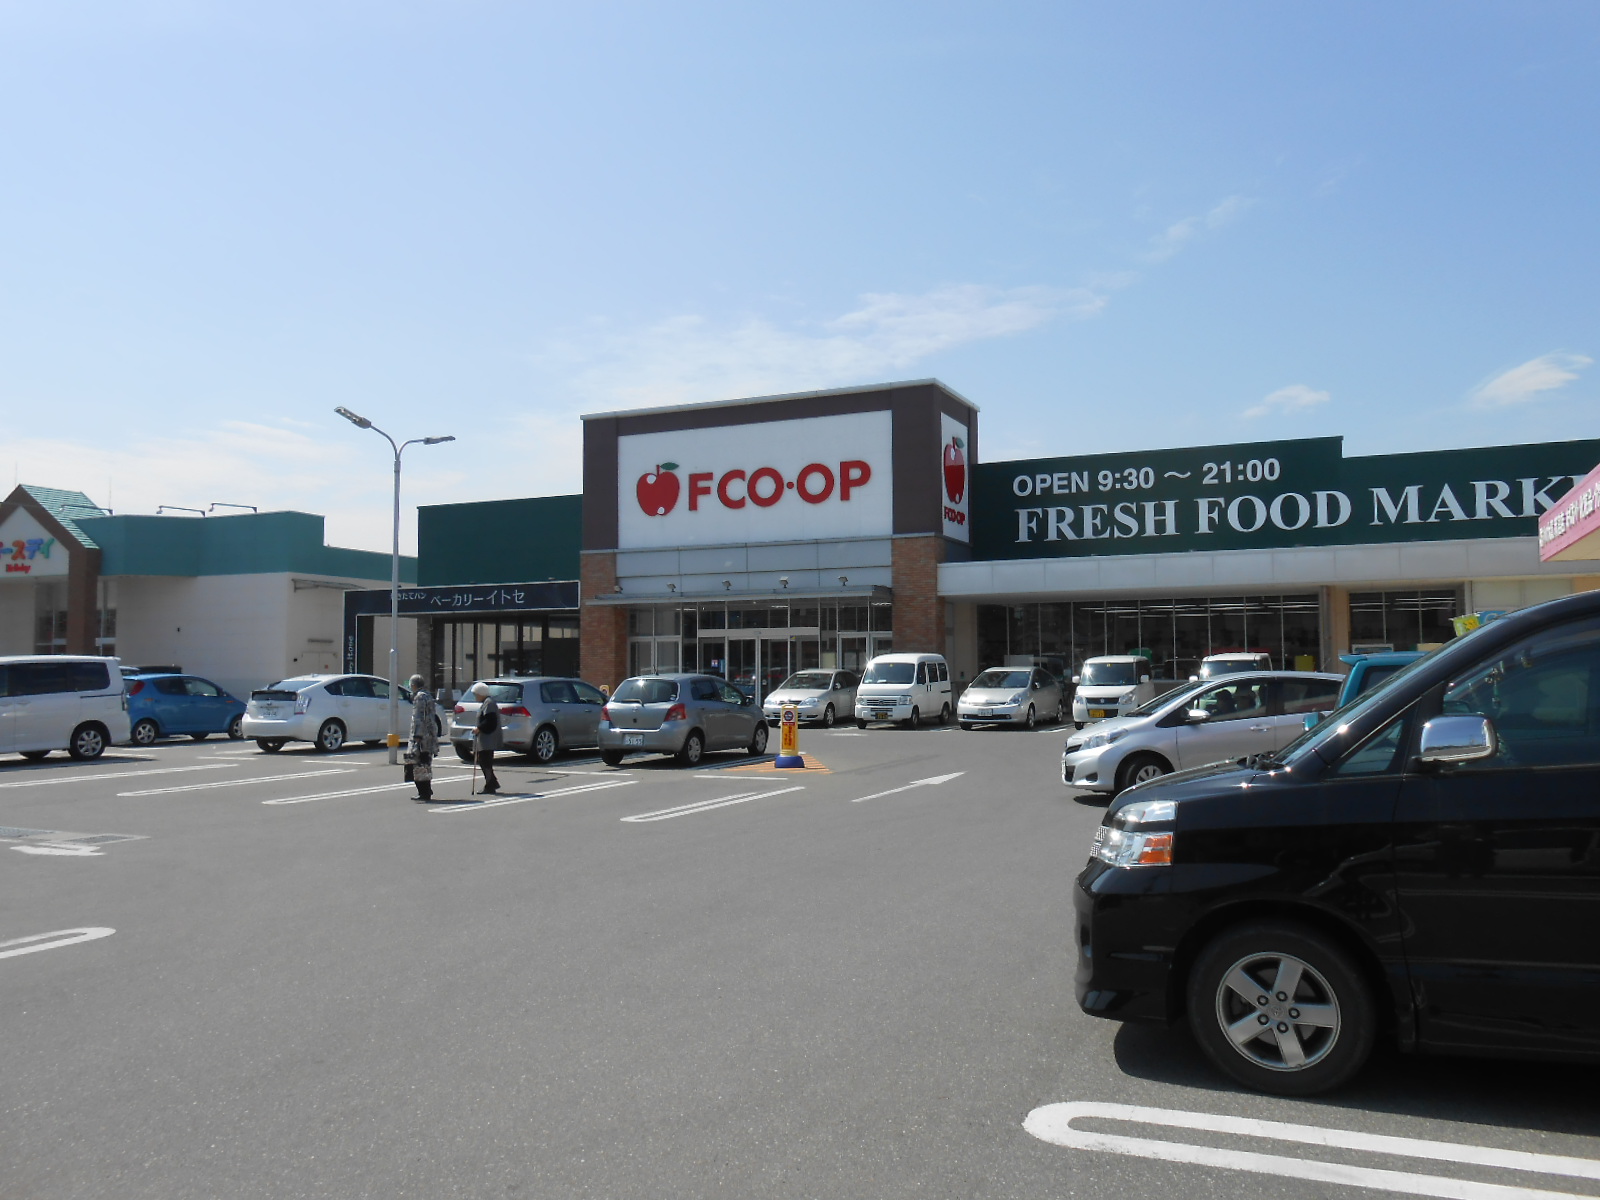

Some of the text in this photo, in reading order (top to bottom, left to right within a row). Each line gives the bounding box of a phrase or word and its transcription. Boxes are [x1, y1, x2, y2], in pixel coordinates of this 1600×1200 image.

[1012, 471, 1090, 497] OPEN
[1097, 466, 1155, 492] 9:30
[1202, 457, 1281, 485] 21:00
[1014, 499, 1181, 543] FRESH
[1193, 490, 1352, 534] FOOD
[1368, 474, 1586, 526] MARK
